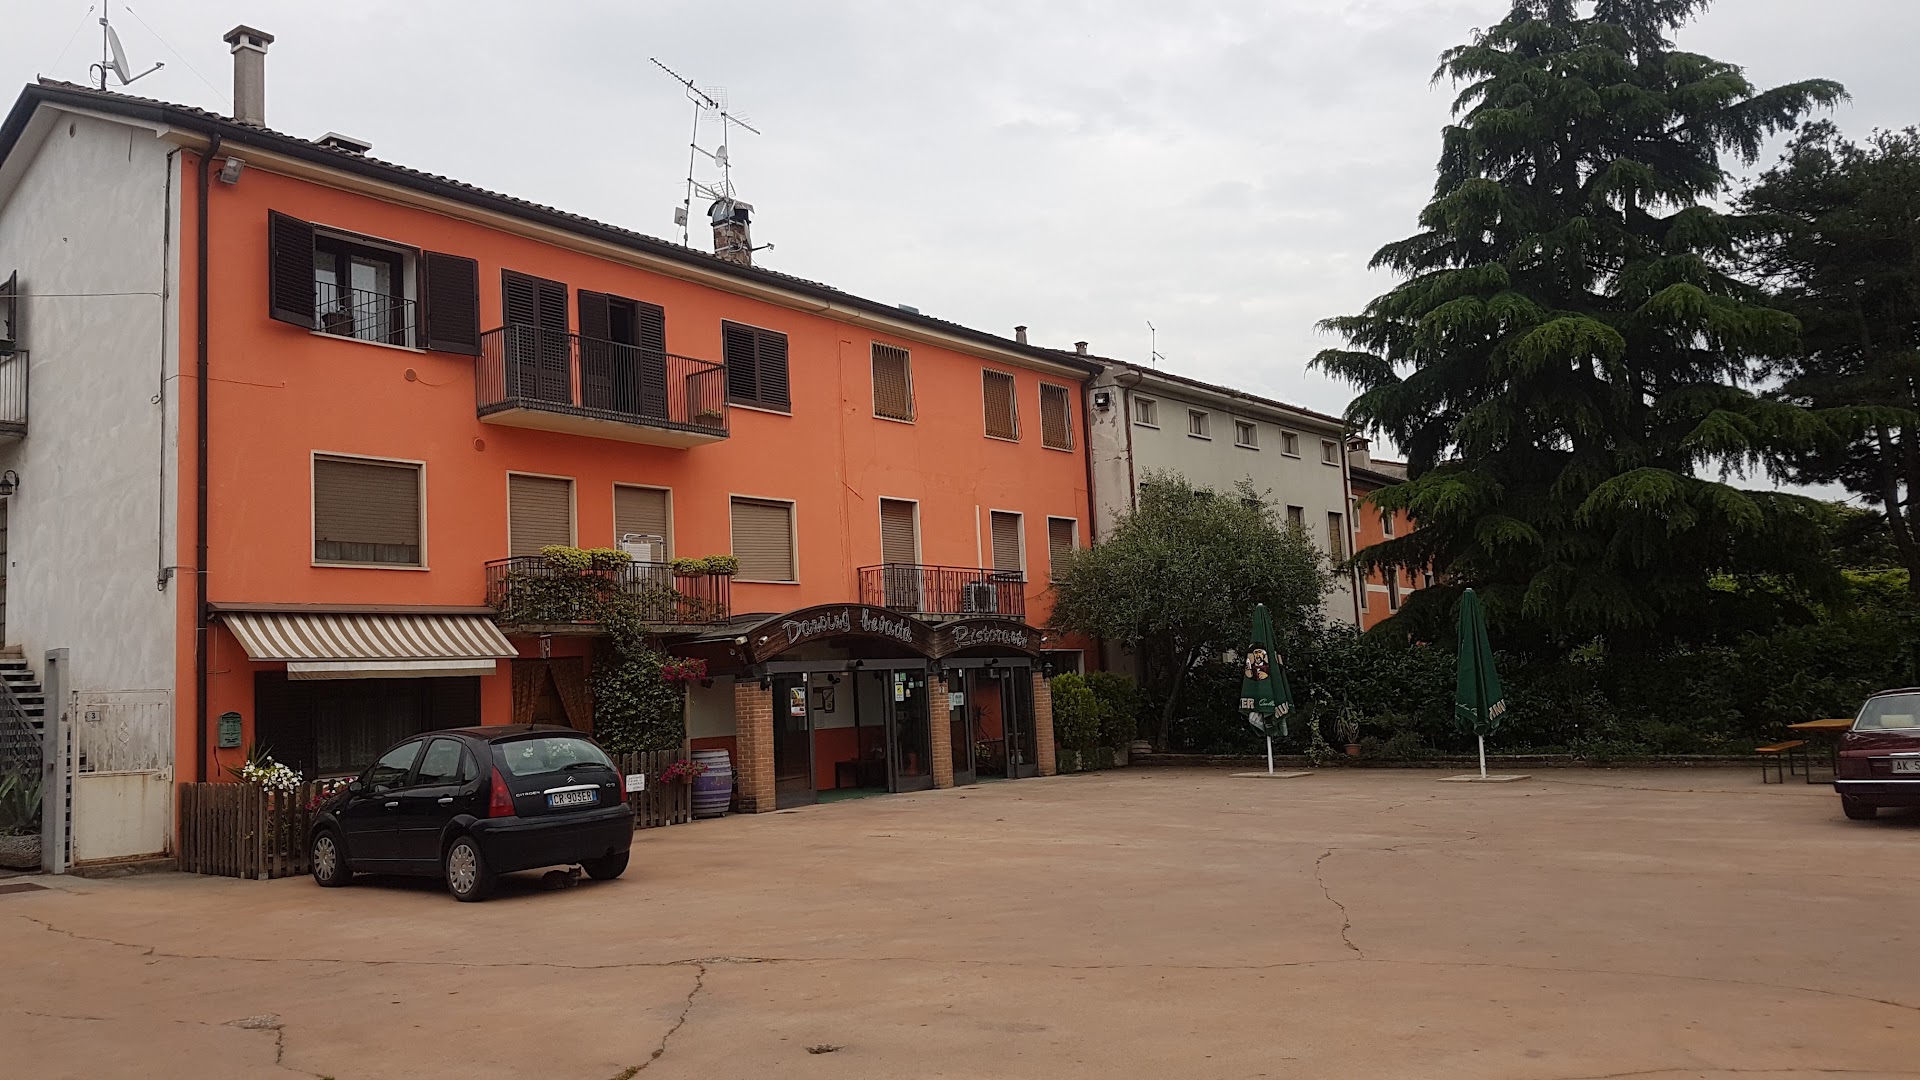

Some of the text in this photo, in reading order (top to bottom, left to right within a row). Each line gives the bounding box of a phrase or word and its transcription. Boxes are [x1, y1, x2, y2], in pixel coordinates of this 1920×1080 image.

[782, 607, 851, 644] Dancing
[1239, 697, 1255, 710] ER
[91, 712, 96, 720] 3
[1896, 761, 1909, 771] AK
[553, 789, 593, 805] CR 903ER
